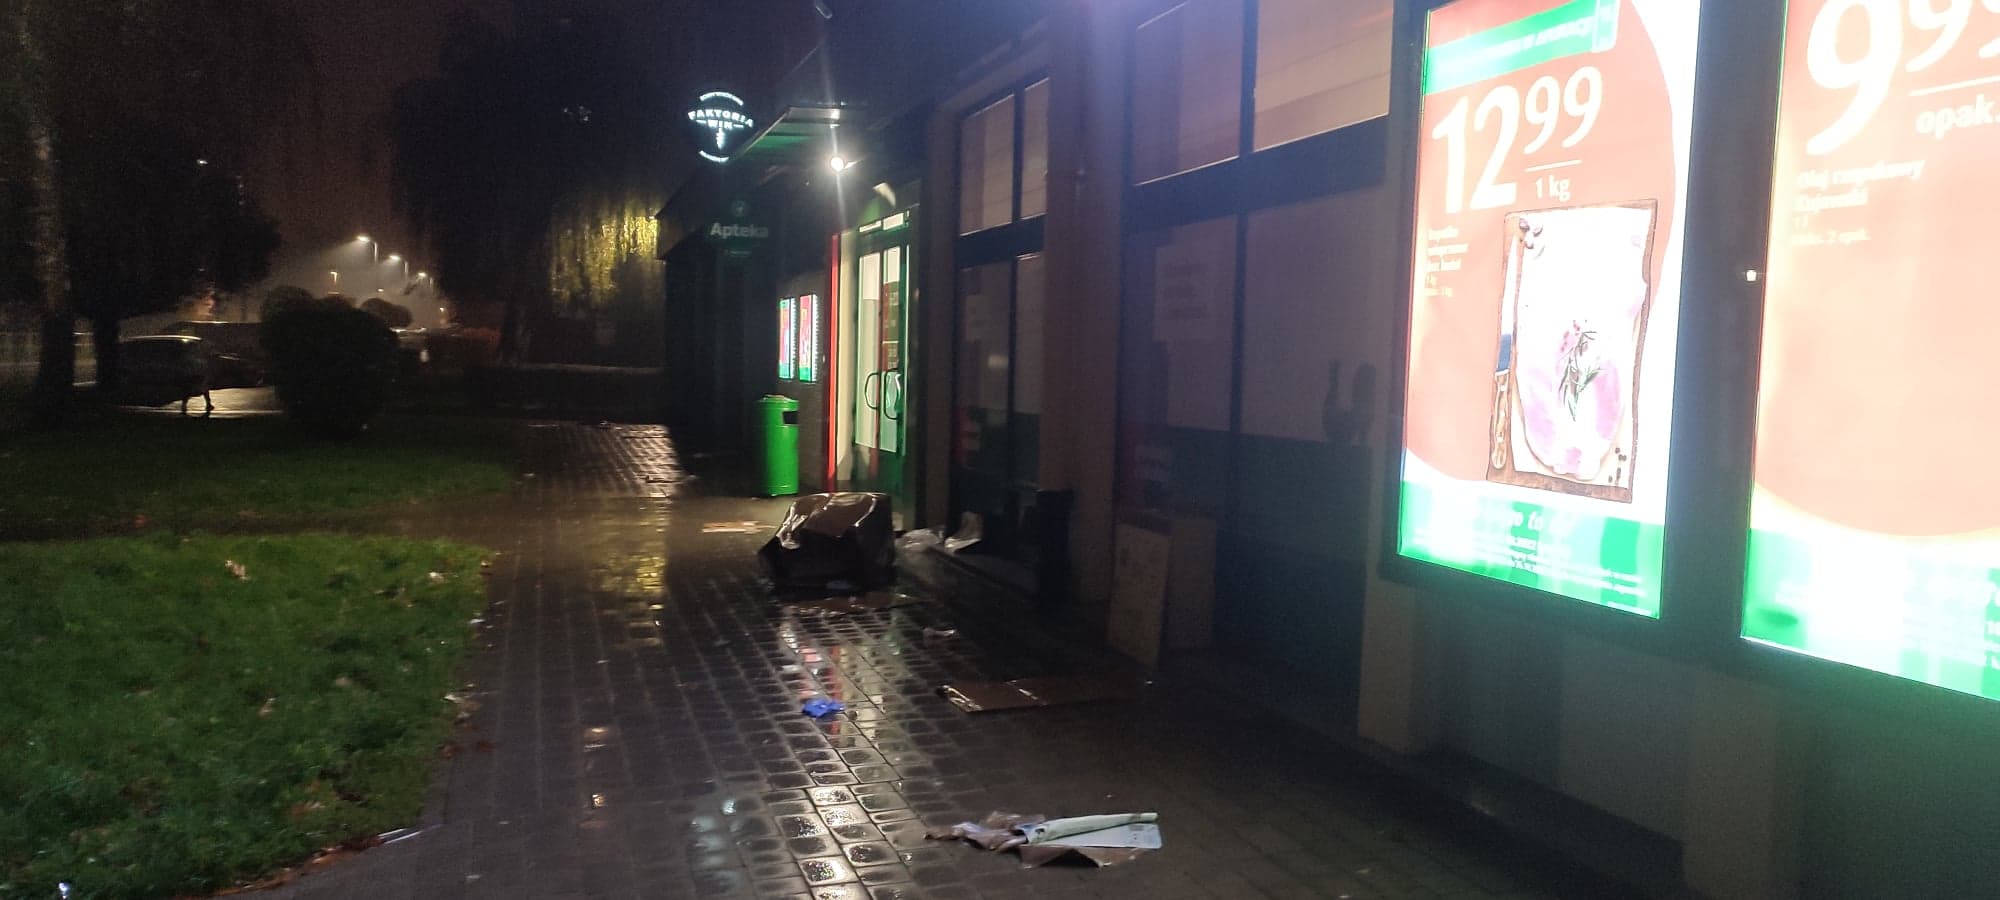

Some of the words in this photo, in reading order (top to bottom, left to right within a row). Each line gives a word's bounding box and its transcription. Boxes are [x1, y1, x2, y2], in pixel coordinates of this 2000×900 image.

[688, 109, 755, 127] FAKTORIA
[707, 119, 733, 131] WIN
[1535, 177, 1543, 199] 1
[1549, 174, 1571, 202] kg
[710, 222, 769, 240] Apteka
